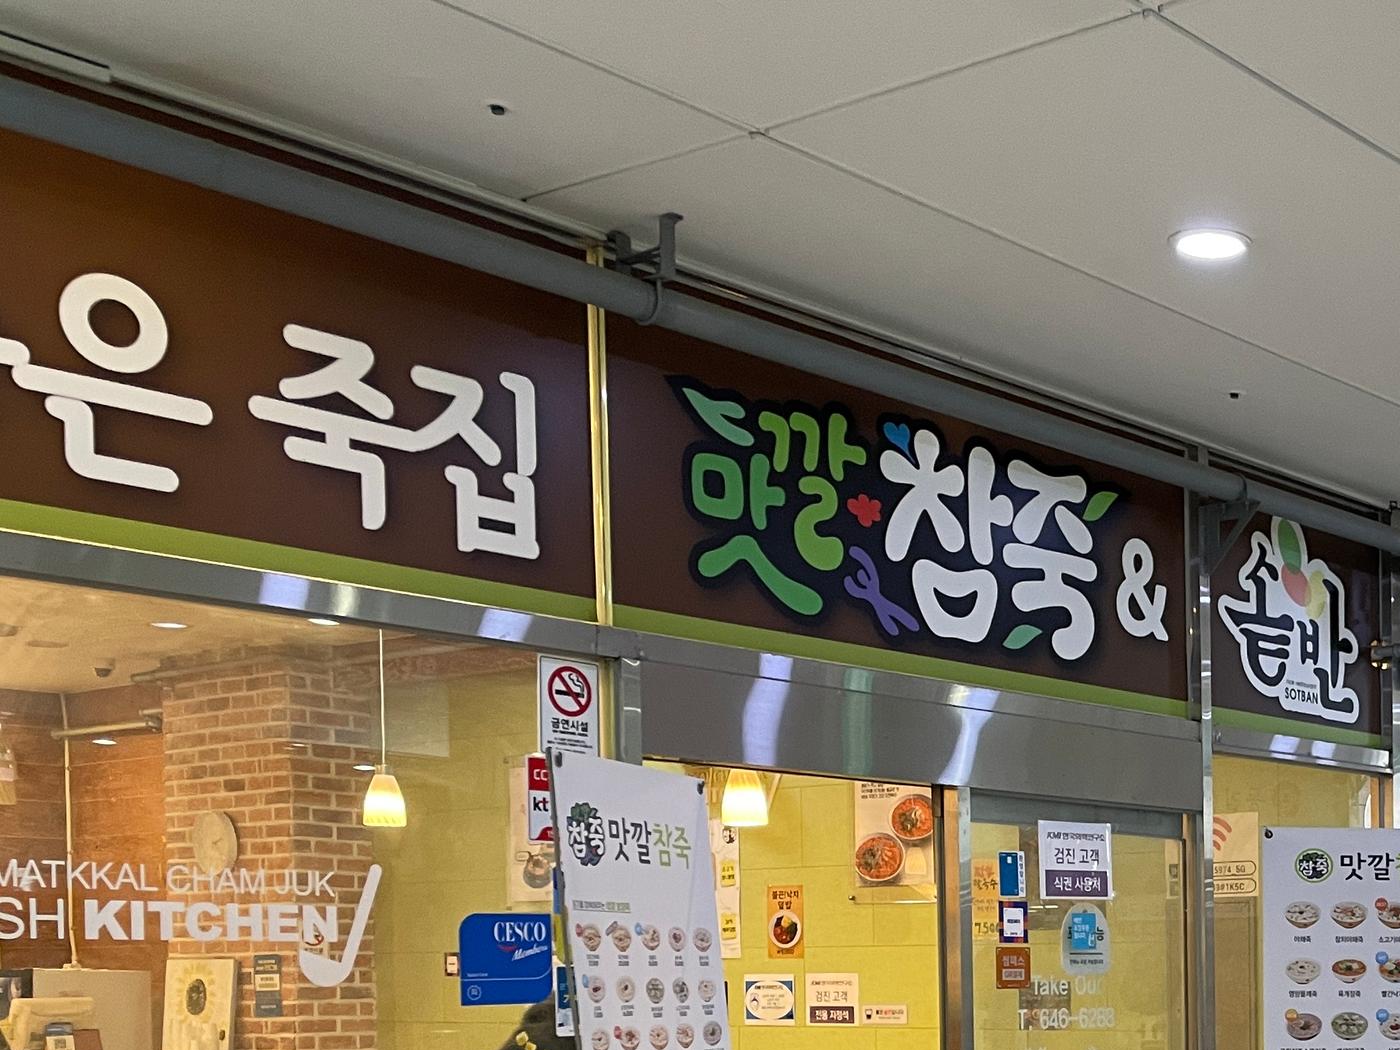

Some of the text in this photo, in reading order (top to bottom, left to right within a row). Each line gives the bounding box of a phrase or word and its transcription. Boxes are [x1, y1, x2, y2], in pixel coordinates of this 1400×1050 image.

[247, 323, 540, 560] 죽집
[691, 410, 1169, 661] 맛깔 참죽 &
[1224, 541, 1354, 714] 솥반
[1284, 686, 1319, 705] SOTBAN
[551, 717, 589, 733] 금연시설
[1054, 847, 1100, 866] 검진 고객
[1299, 857, 1330, 879] 참죽
[166, 865, 267, 895] CHAM
[274, 870, 336, 897] JUK
[1053, 876, 1101, 892] 식권 사용처
[83, 899, 339, 943] KITCHEN
[493, 921, 547, 942] CESCO
[1031, 976, 1069, 996] Take
